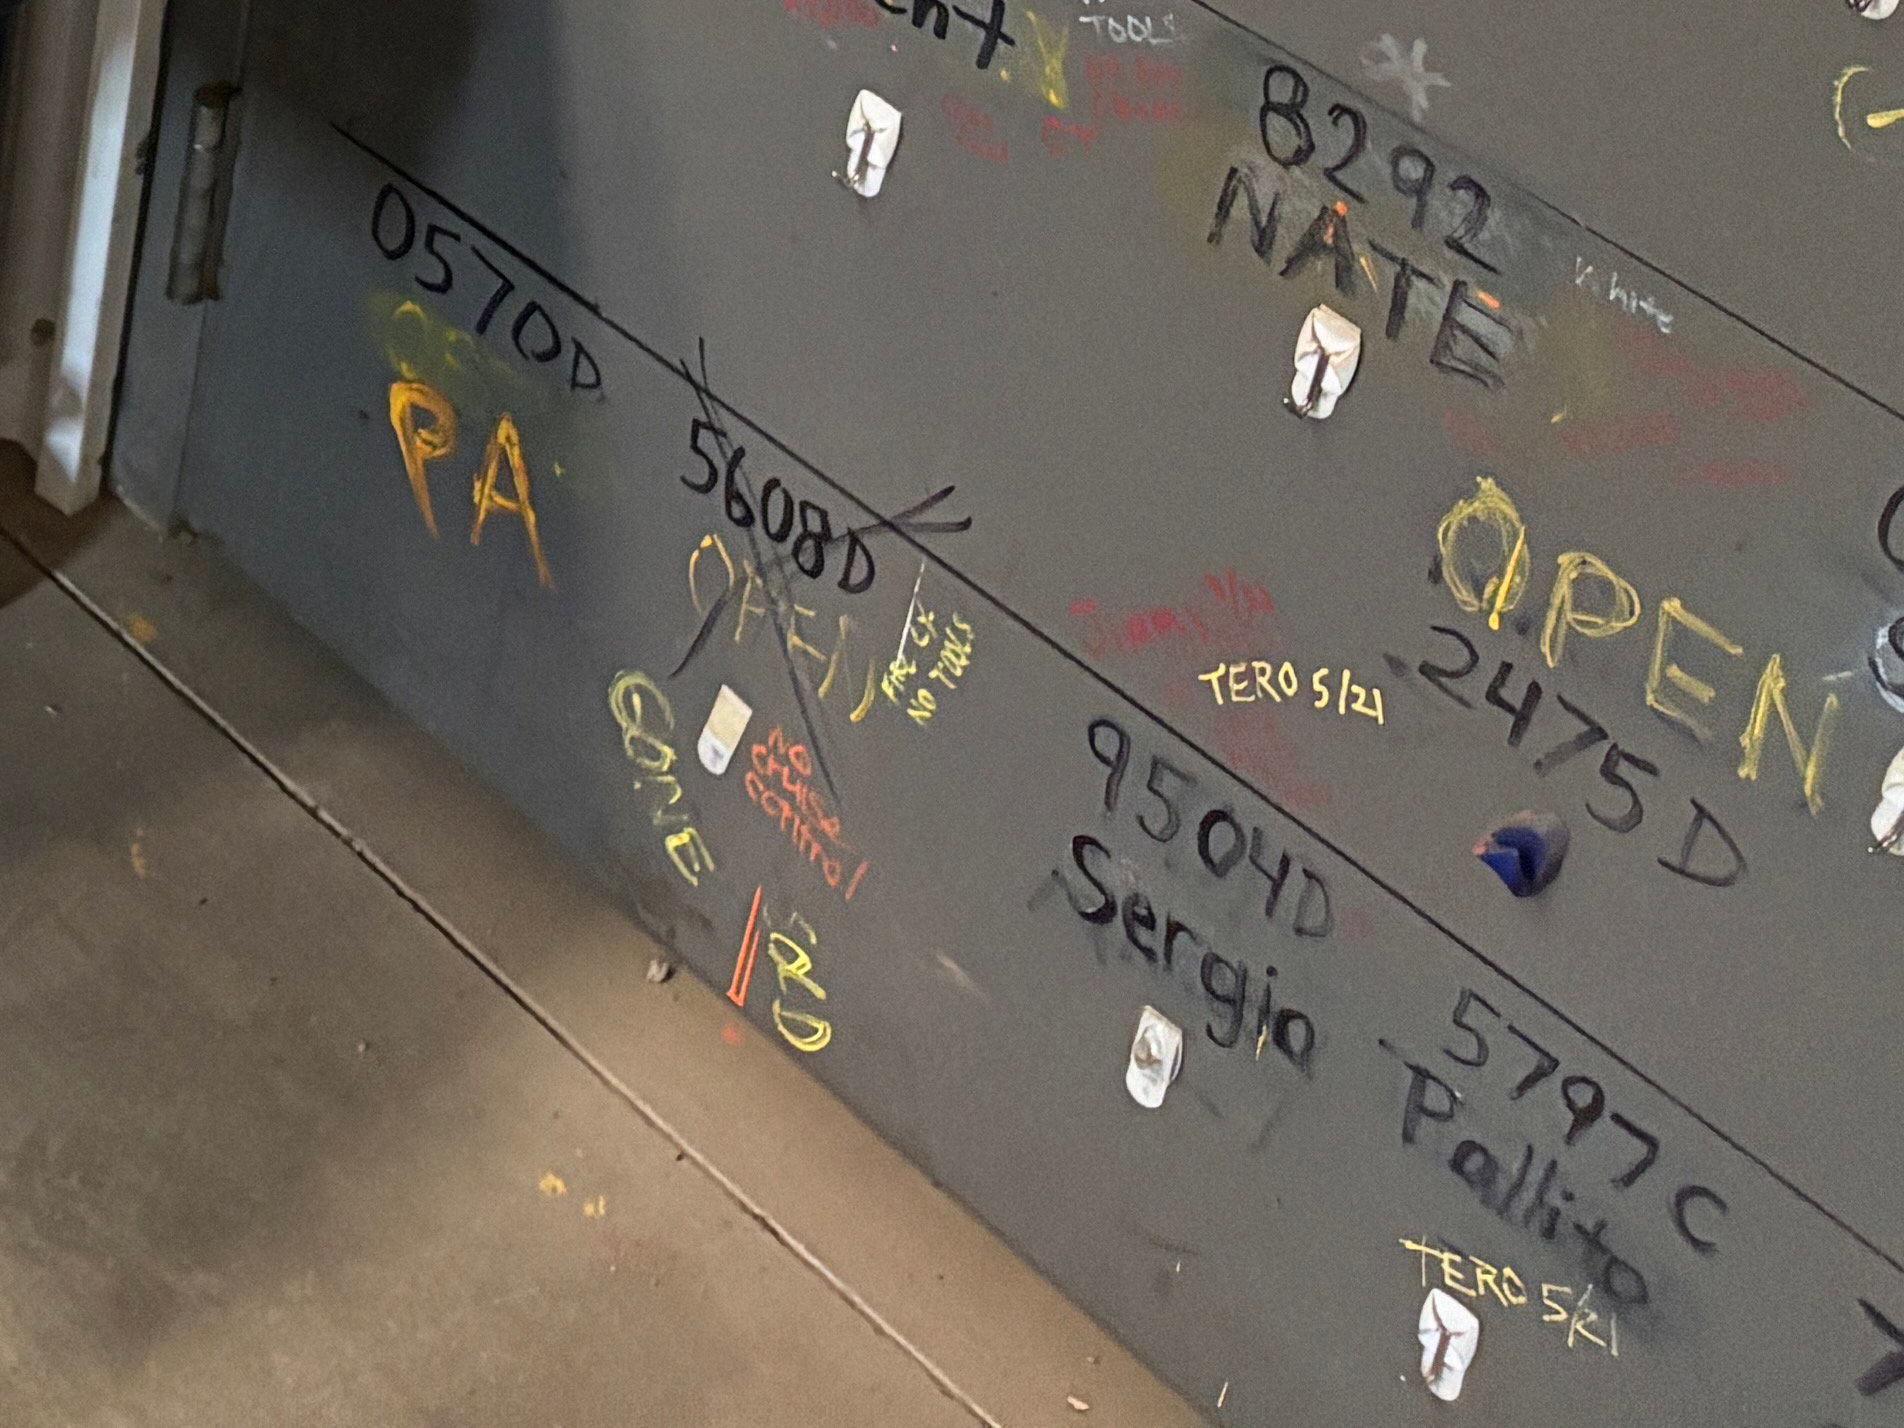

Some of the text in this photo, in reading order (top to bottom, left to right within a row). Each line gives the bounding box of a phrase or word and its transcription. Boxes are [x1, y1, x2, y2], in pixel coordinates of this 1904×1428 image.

[1205, 164, 1508, 392] NATE
[1259, 63, 1503, 276] 8292
[371, 181, 605, 394] 0570D
[389, 380, 556, 592] PA
[679, 417, 876, 595] 5608D
[1198, 661, 1386, 726] TERO 5/21
[1437, 475, 1841, 817] OPEN
[1088, 717, 1335, 939] 9504D
[1418, 624, 1749, 890] 2475D
[1052, 833, 1318, 1077] Sergio
[1442, 988, 1730, 1256] 5797C
[1398, 1235, 1528, 1309] TERO
